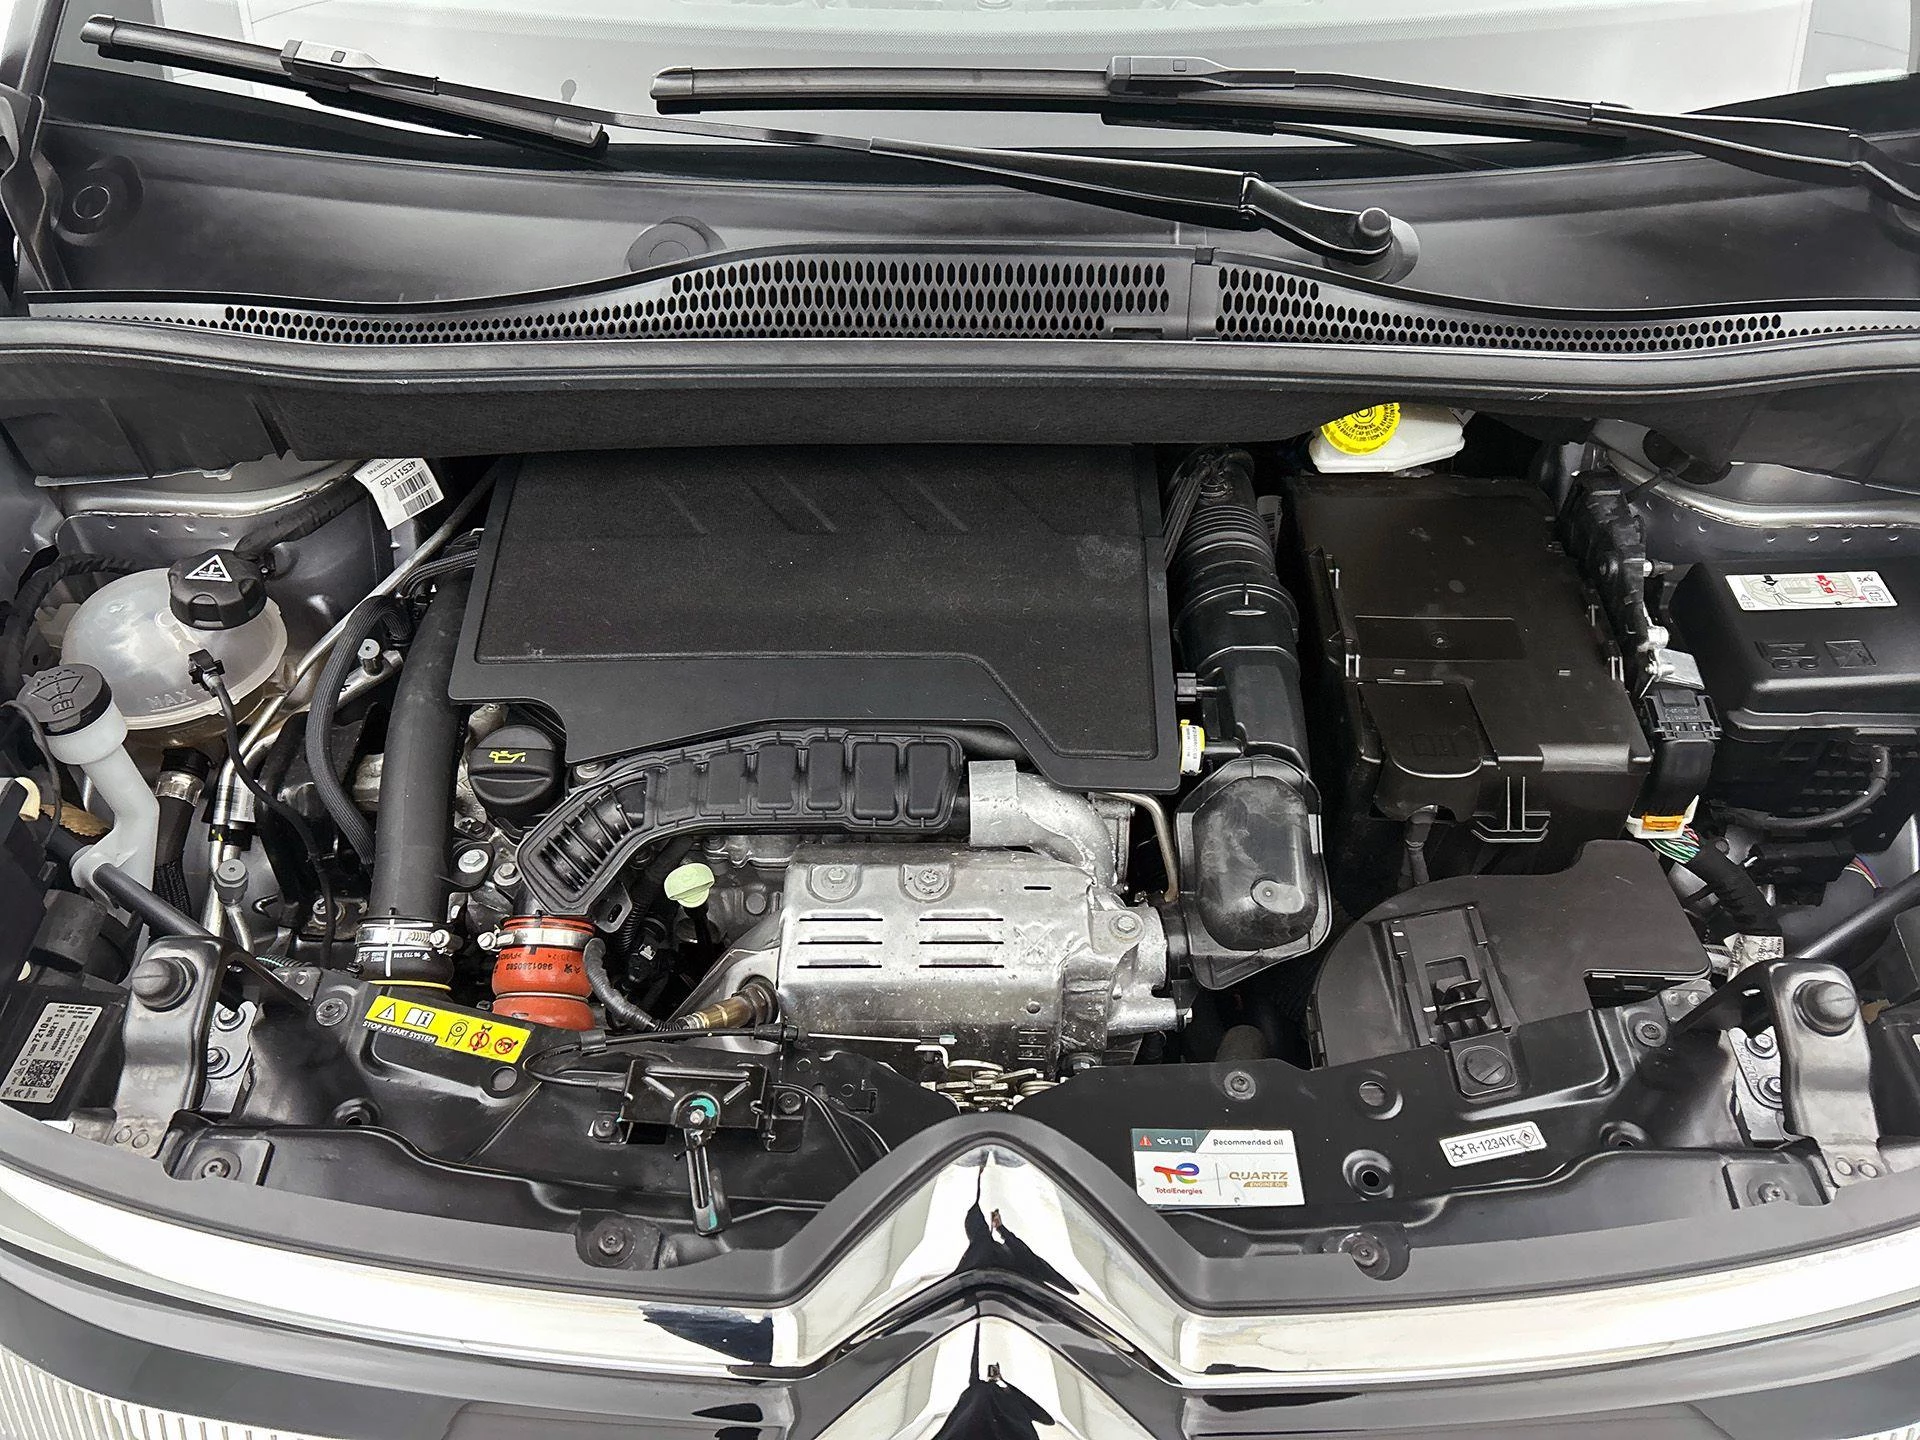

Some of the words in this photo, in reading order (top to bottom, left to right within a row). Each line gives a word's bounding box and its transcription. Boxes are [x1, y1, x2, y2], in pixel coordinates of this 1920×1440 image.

[145, 689, 193, 709] MAX
[362, 1020, 382, 1030] STOP
[387, 1026, 409, 1037] START
[408, 1031, 436, 1043] SYSTEM
[1213, 1138, 1271, 1146] Recommended
[1273, 1138, 1284, 1146] oil
[1229, 1171, 1289, 1181] QUARTZ
[1155, 1187, 1203, 1195] TotalEnergies
